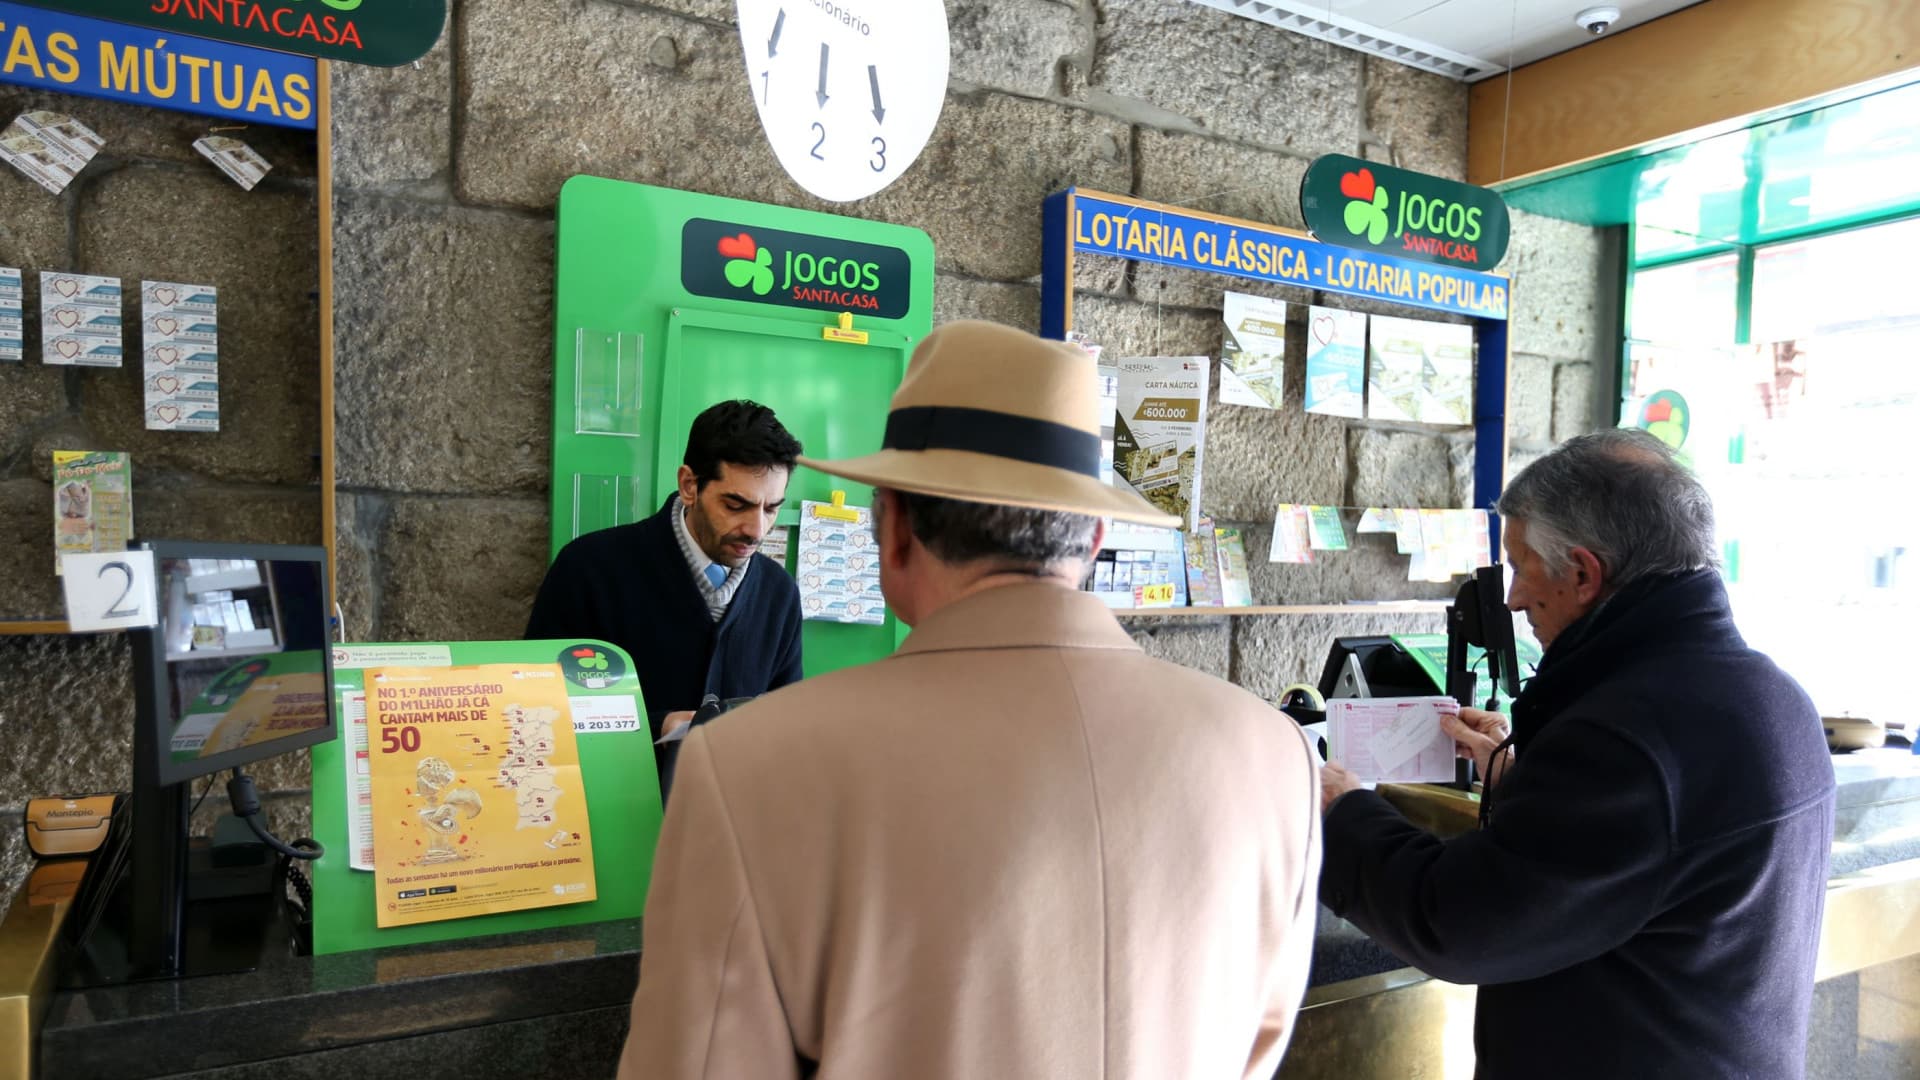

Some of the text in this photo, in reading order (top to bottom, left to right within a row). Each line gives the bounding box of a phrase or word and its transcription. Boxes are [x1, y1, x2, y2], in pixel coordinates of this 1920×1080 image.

[810, 0, 870, 36] cionário
[0, 22, 312, 121] AS MÚTUAS
[761, 70, 769, 106] 1
[810, 122, 825, 161] 2
[869, 136, 886, 172] 3
[1394, 190, 1482, 241] JOGOS
[1075, 209, 1188, 261] LOTARIA
[1193, 230, 1310, 282] CLÁSSICA
[1327, 255, 1414, 299] LOTARIA
[1418, 271, 1506, 314] POPULAR
[1403, 232, 1478, 263] SANTACASA
[781, 250, 880, 291] JOGOS
[793, 286, 879, 310] SANTACASA
[1145, 380, 1198, 389] CARTA NÁUTICA
[98, 561, 140, 620] 2
[577, 671, 611, 680] JOGOS
[378, 687, 397, 698] NO
[419, 683, 503, 698] ANIVERSÁRIO
[378, 700, 397, 711] DO
[456, 696, 470, 708] JÁ
[473, 694, 490, 708] CÁ
[380, 709, 488, 725] CANTAM MAIS DE
[589, 721, 611, 729] 203
[615, 720, 635, 729] 377
[382, 726, 420, 754] 50
[47, 808, 94, 817] Montepio
[387, 877, 405, 885] Todas
